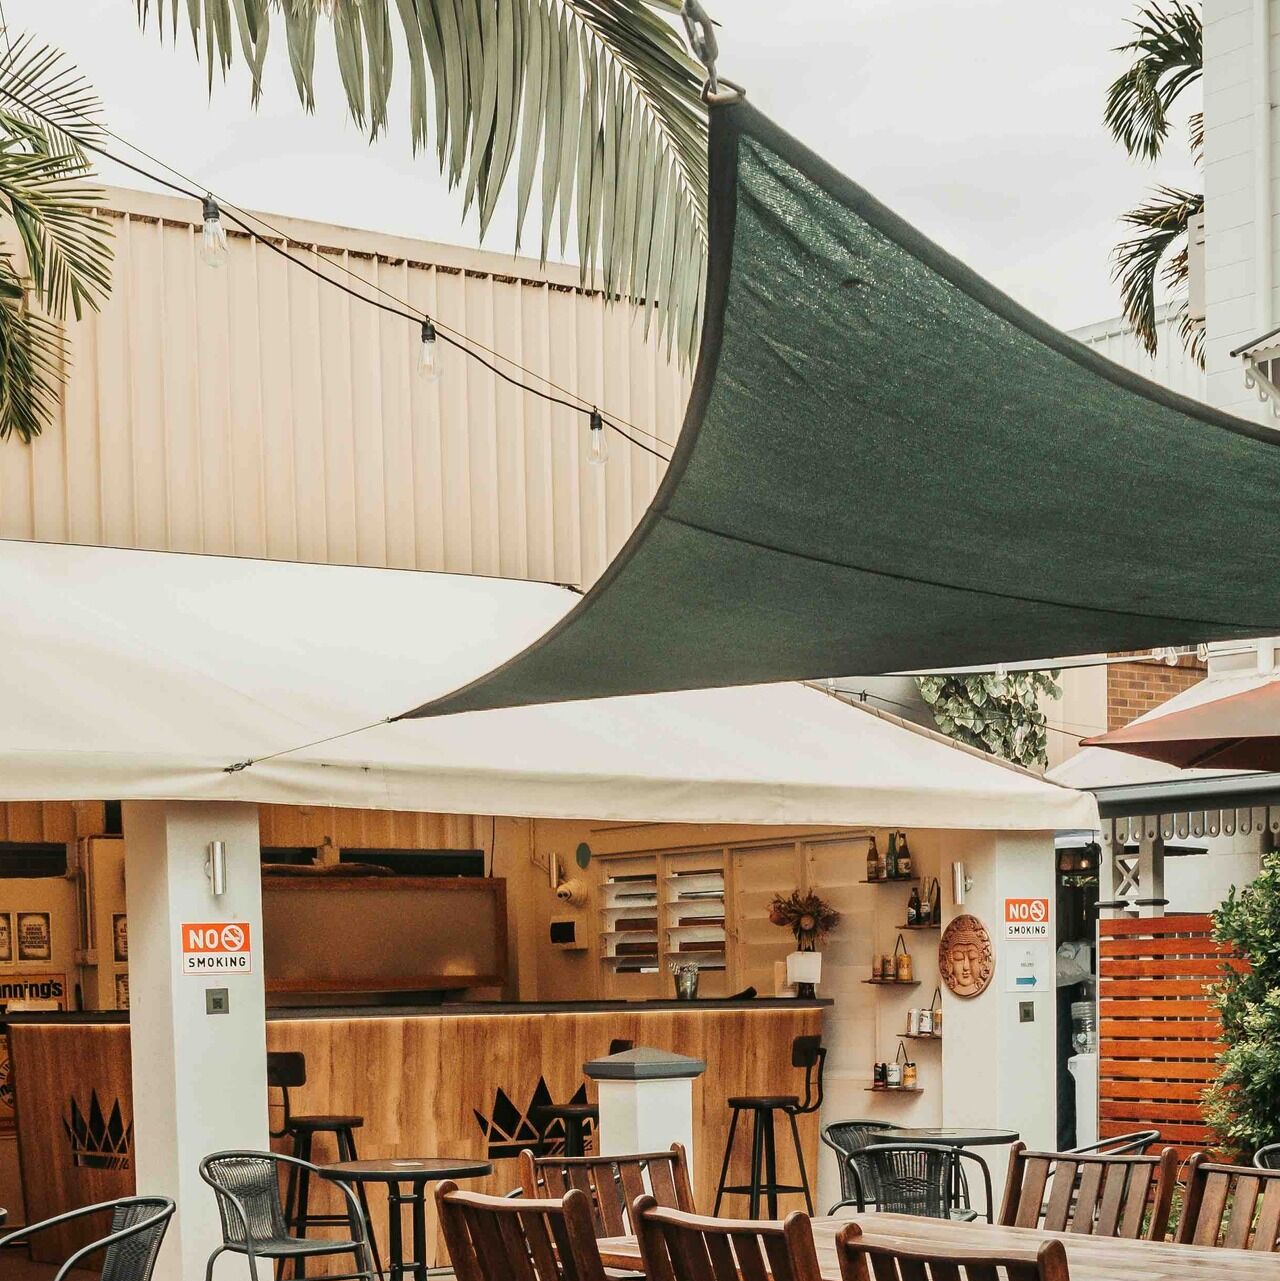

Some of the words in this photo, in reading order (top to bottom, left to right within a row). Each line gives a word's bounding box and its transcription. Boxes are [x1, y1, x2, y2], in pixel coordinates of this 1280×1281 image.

[1009, 903, 1029, 919] NO
[1008, 926, 1046, 935] SMOKING
[189, 928, 219, 949] NO
[188, 956, 246, 968] SMOKING
